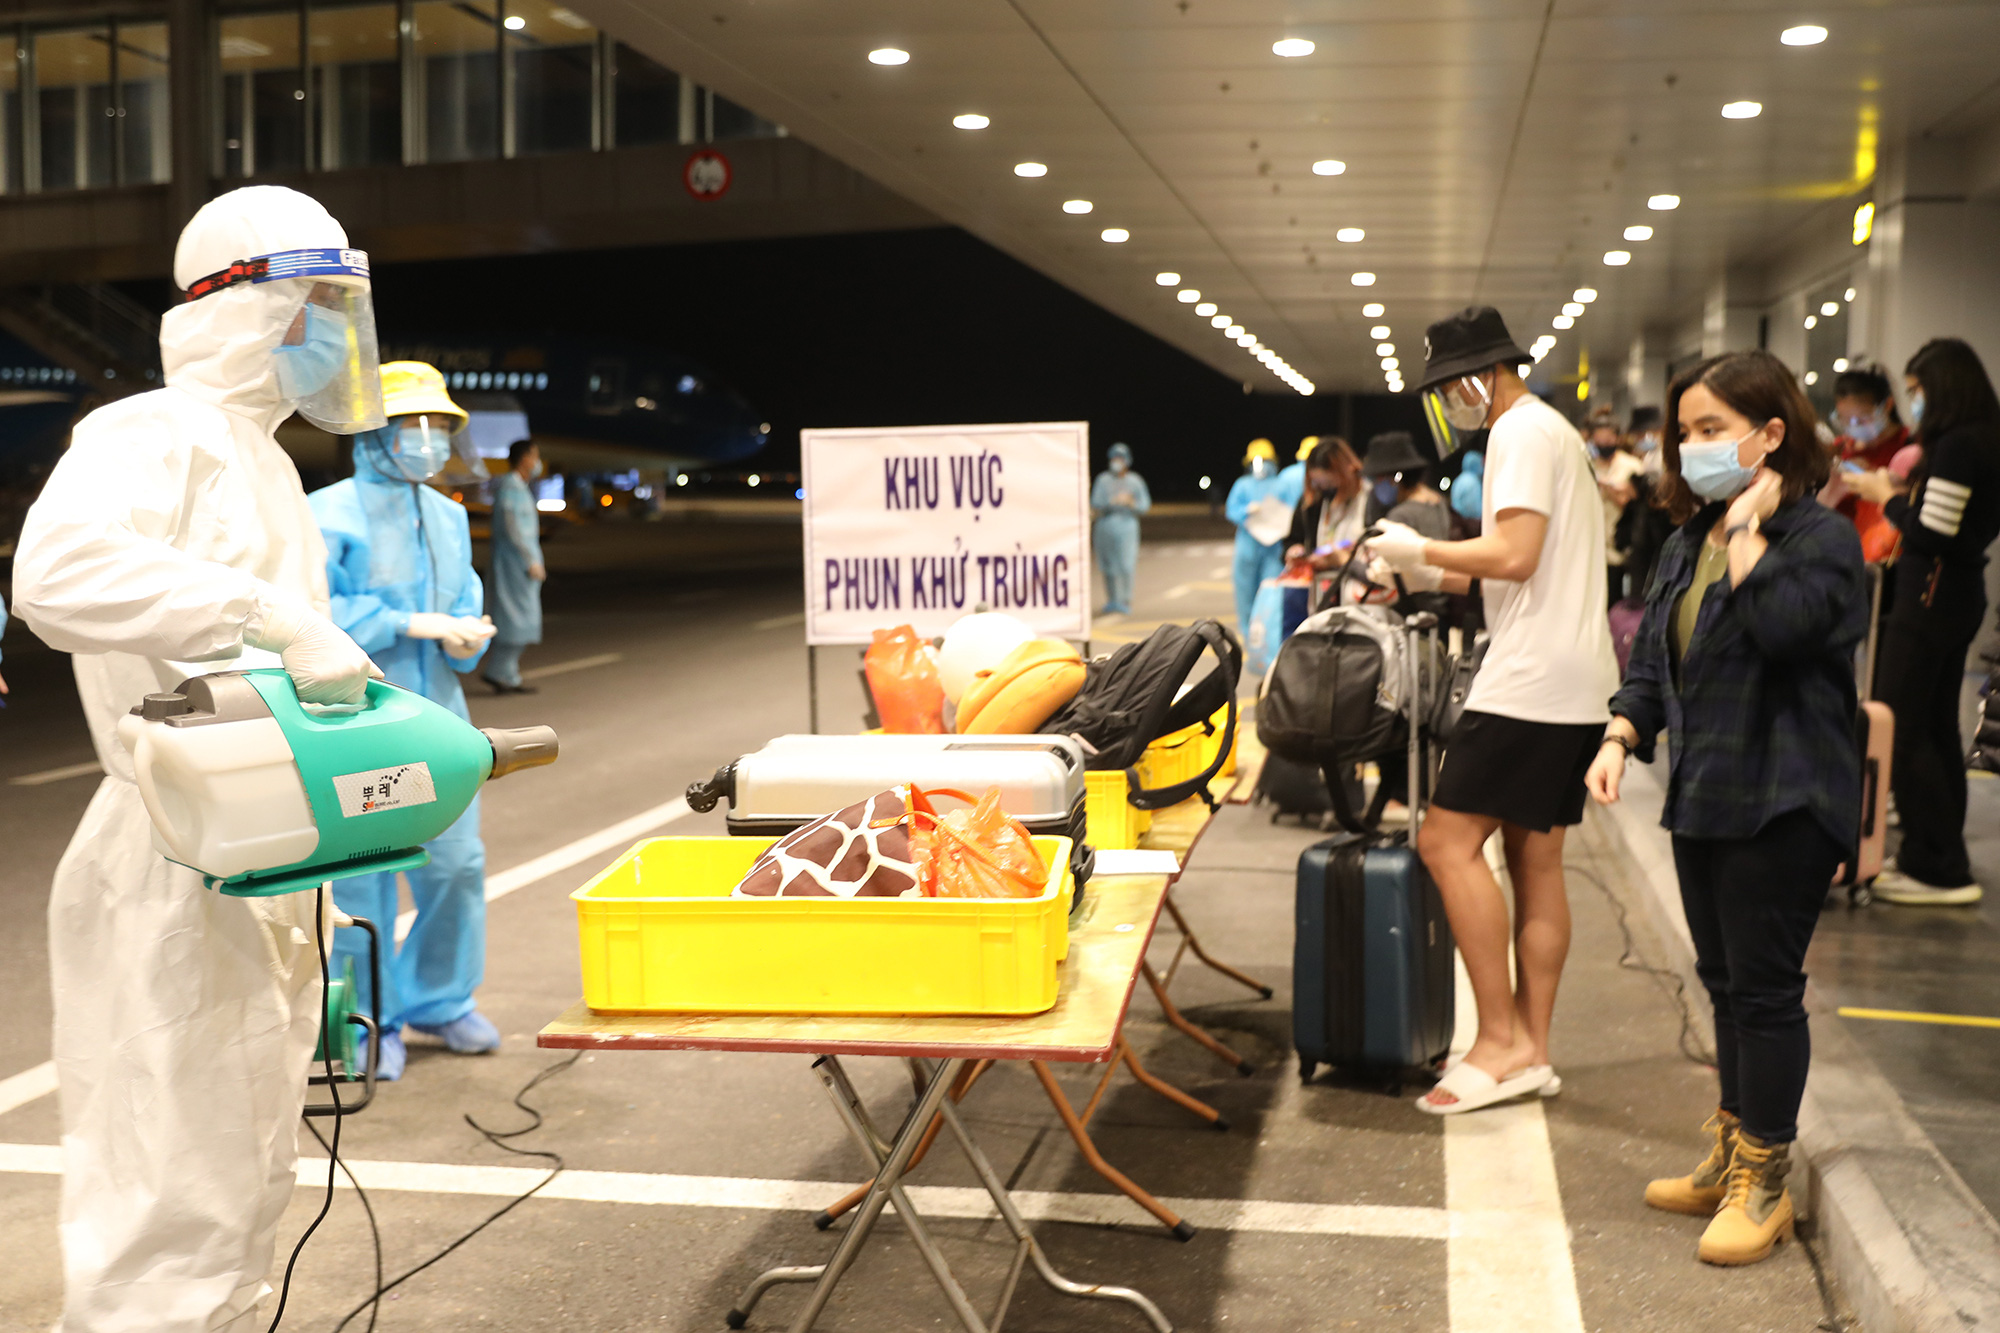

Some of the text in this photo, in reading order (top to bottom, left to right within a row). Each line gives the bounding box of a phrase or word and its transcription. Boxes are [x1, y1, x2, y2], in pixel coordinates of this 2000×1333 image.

[885, 449, 1003, 522] KHU VỰC
[825, 537, 1069, 611] PHUN KHỬ TRÙNG
